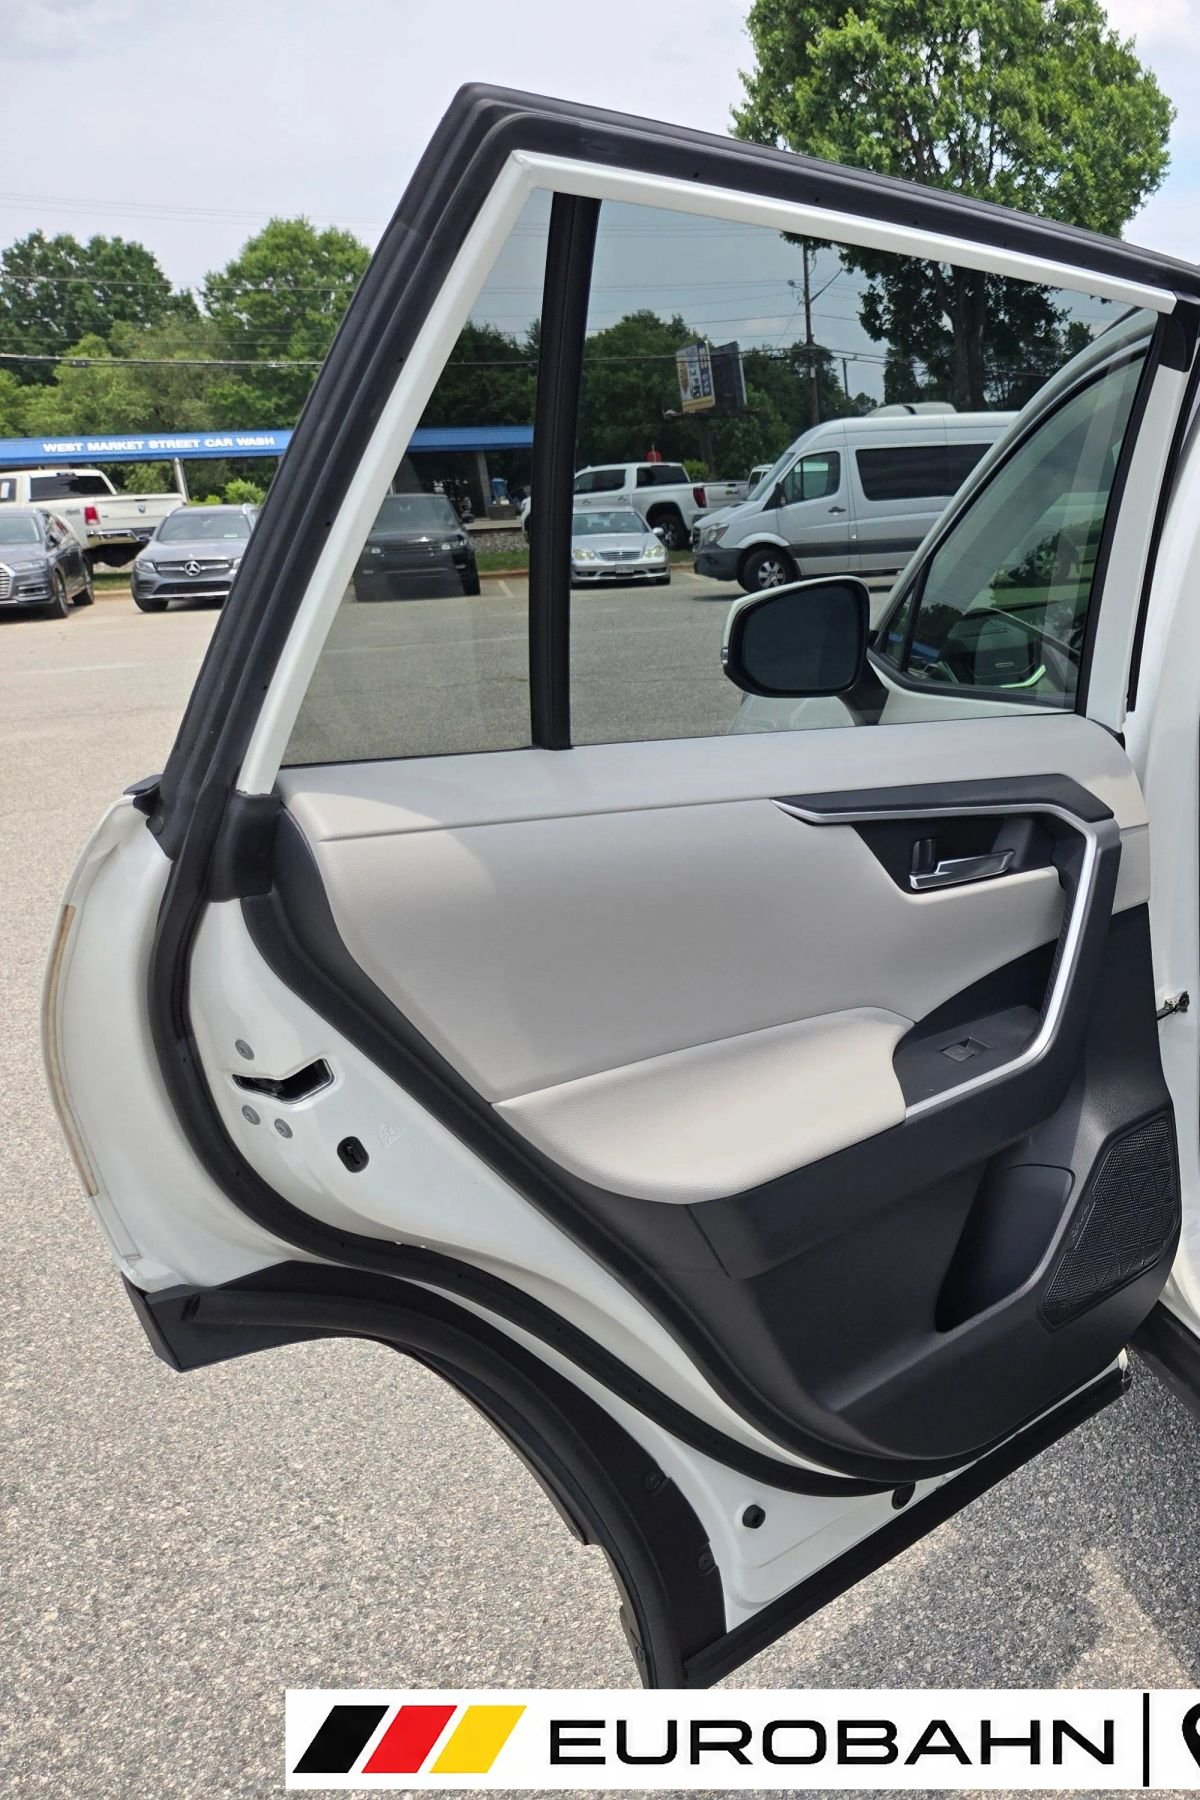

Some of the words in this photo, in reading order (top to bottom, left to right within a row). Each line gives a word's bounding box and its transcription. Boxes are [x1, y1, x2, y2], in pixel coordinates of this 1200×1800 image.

[43, 443, 83, 453] WEST
[87, 440, 145, 451] MARKET
[148, 438, 201, 449] STREET
[204, 437, 234, 448] CAR
[236, 436, 275, 447] WASH
